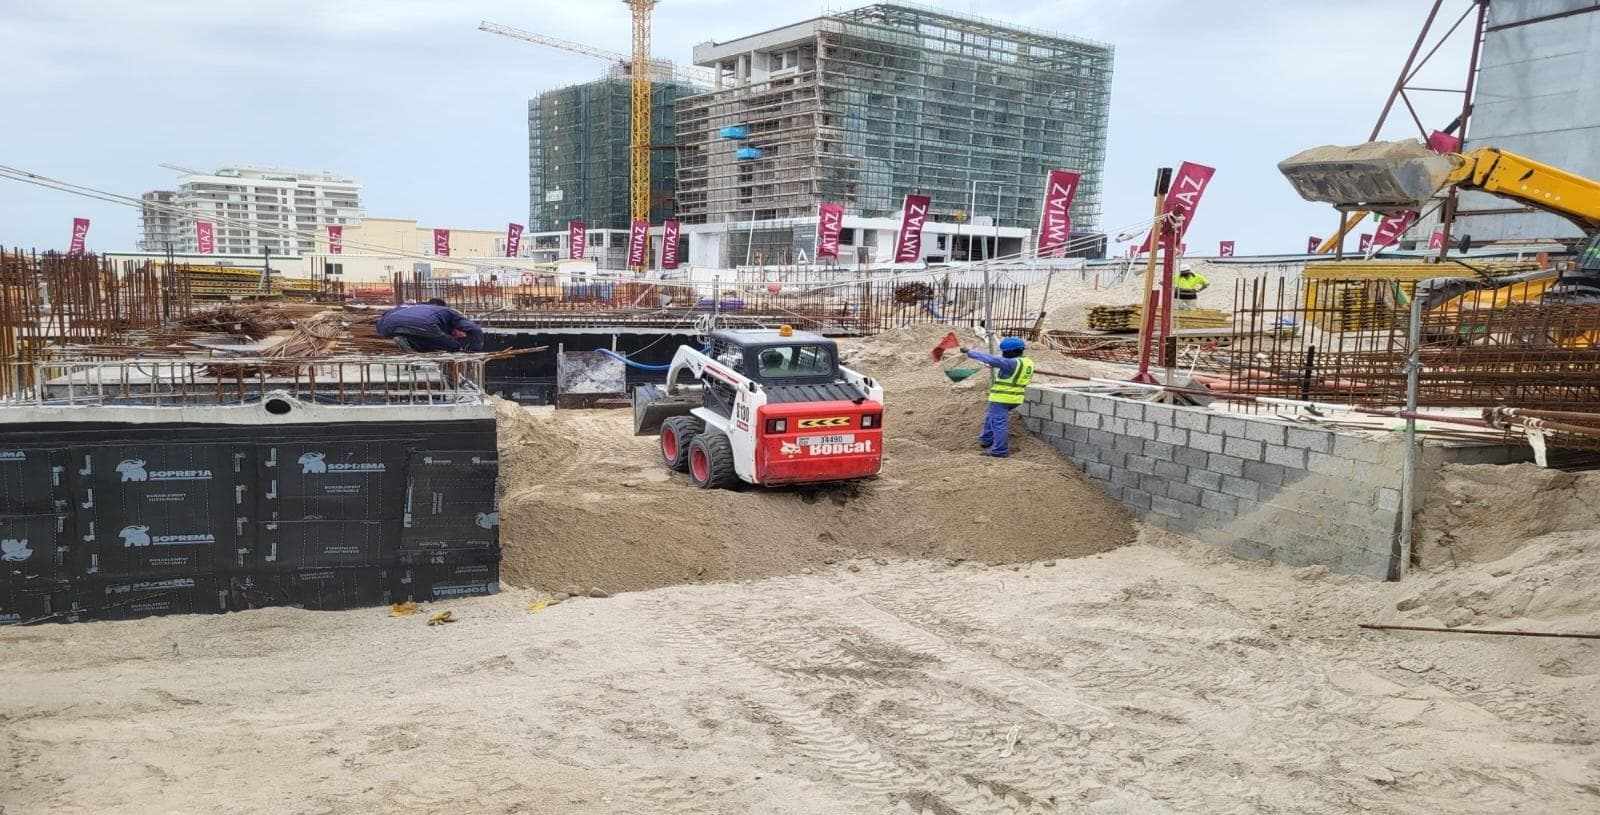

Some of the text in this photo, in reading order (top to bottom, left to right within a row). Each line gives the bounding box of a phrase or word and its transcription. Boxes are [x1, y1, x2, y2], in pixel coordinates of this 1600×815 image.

[901, 204, 926, 258] IMTIAZ
[1047, 183, 1072, 249] IMTIAZ
[631, 226, 646, 262] IMTIAZ
[664, 227, 677, 264] IMTIAZ
[736, 402, 749, 422] S130
[152, 534, 215, 543] SOPREMA
